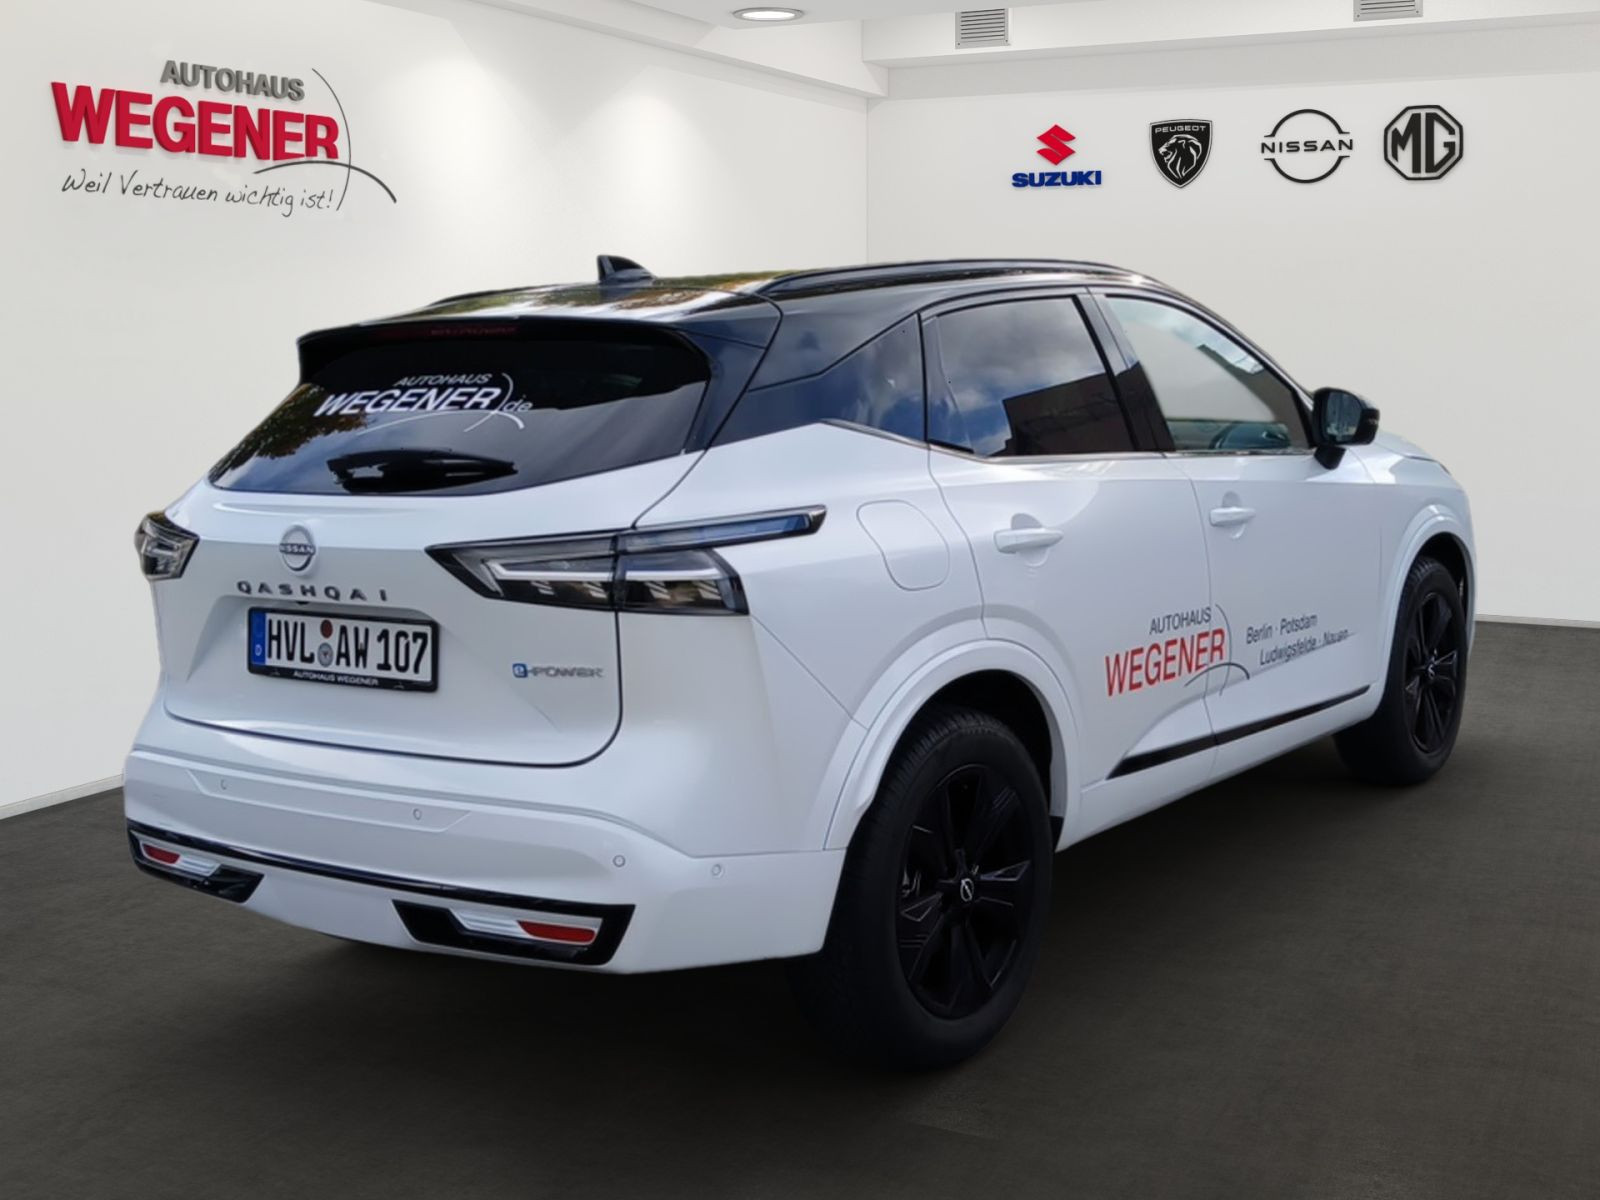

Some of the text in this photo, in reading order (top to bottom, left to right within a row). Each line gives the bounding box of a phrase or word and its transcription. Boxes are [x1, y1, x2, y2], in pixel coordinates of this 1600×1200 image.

[160, 60, 305, 101] AUTOHAUS
[51, 82, 339, 161] WEGENER
[1154, 124, 1206, 134] PEUGEOT
[1261, 138, 1353, 154] NISSAN
[1391, 112, 1455, 174] MG
[61, 168, 334, 217] Weil Vertrauen wichtig ist!
[1011, 170, 1102, 188] SUZUKI
[393, 373, 492, 387] AUTOHAUS
[313, 387, 502, 417] WEGENER
[236, 580, 388, 601] QASHQAI
[1150, 606, 1212, 635] AUTOHAUS
[1246, 614, 1318, 645] Berlin Potsdam
[267, 618, 429, 675] HVL AW 107
[1105, 627, 1226, 698] WEGENER
[293, 670, 379, 687] AUTOHAUS WEGENER
